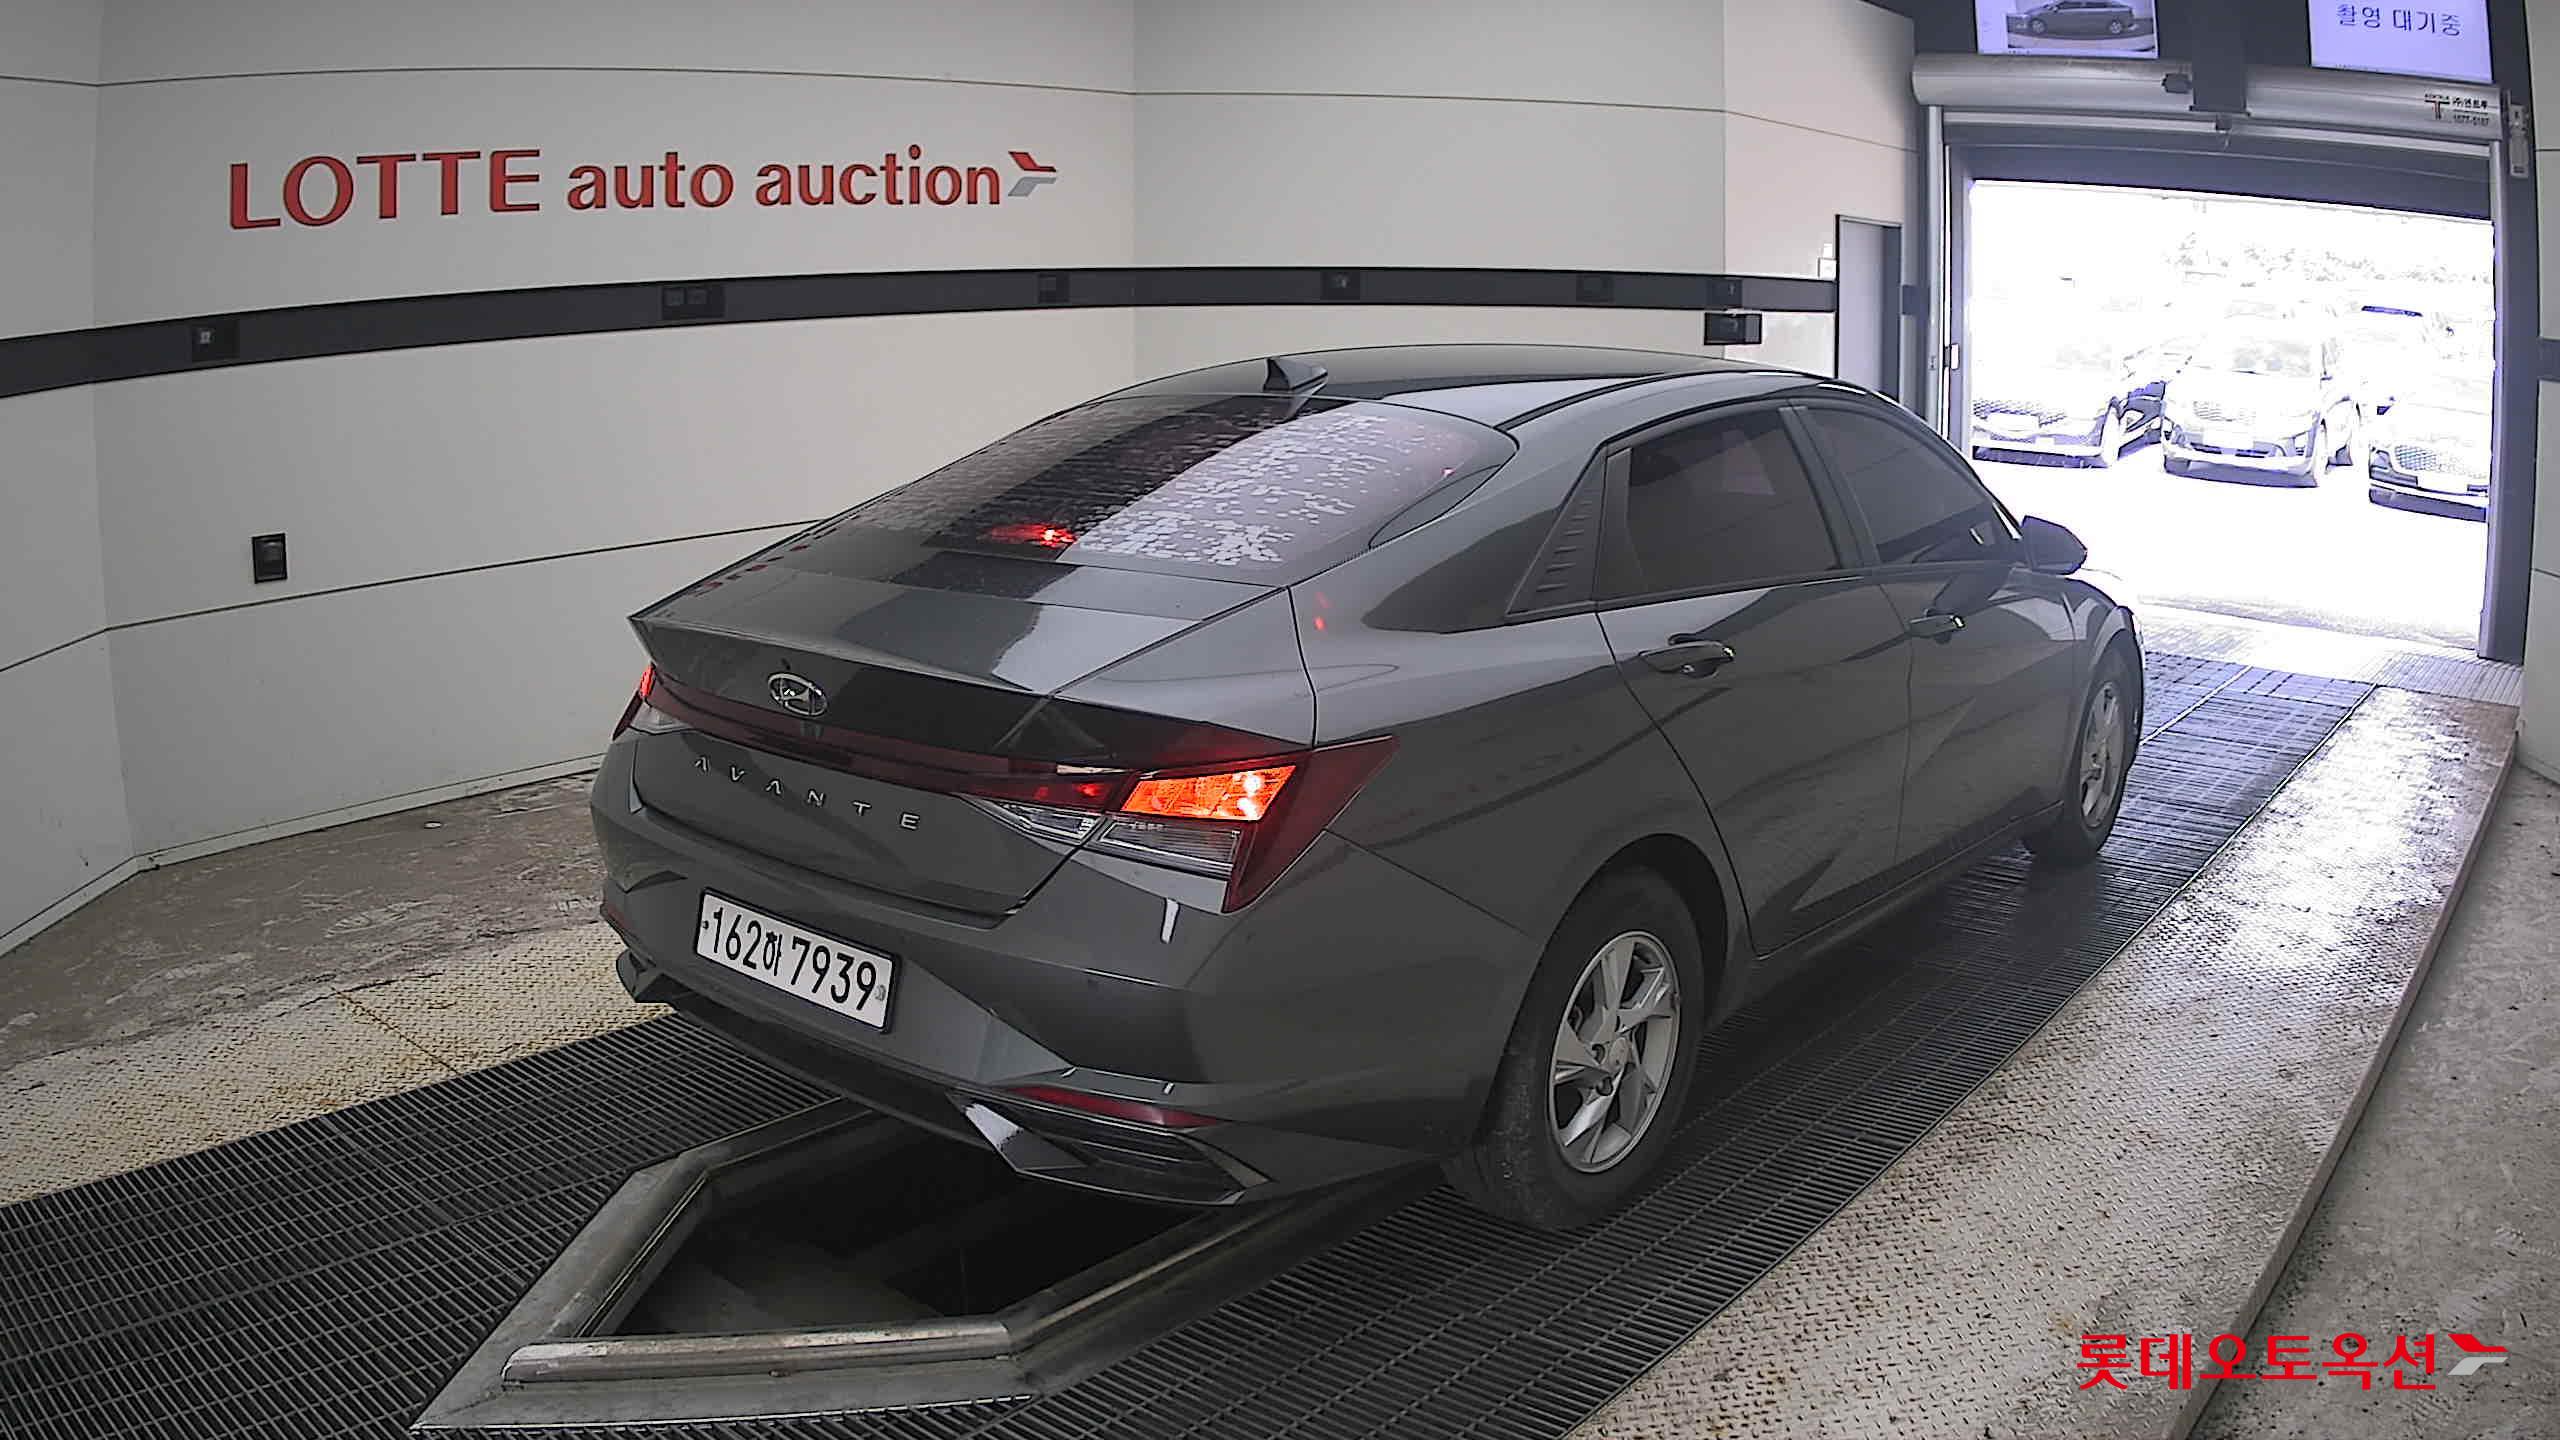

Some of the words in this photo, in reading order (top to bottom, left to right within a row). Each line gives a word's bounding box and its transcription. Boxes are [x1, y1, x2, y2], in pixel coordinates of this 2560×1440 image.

[2337, 4, 2381, 29] 촬영
[2392, 9, 2461, 36] 대기중
[229, 148, 541, 230] LOTTE
[567, 150, 735, 210] auto
[754, 143, 1001, 206] auction
[695, 756, 920, 830] AVANTE
